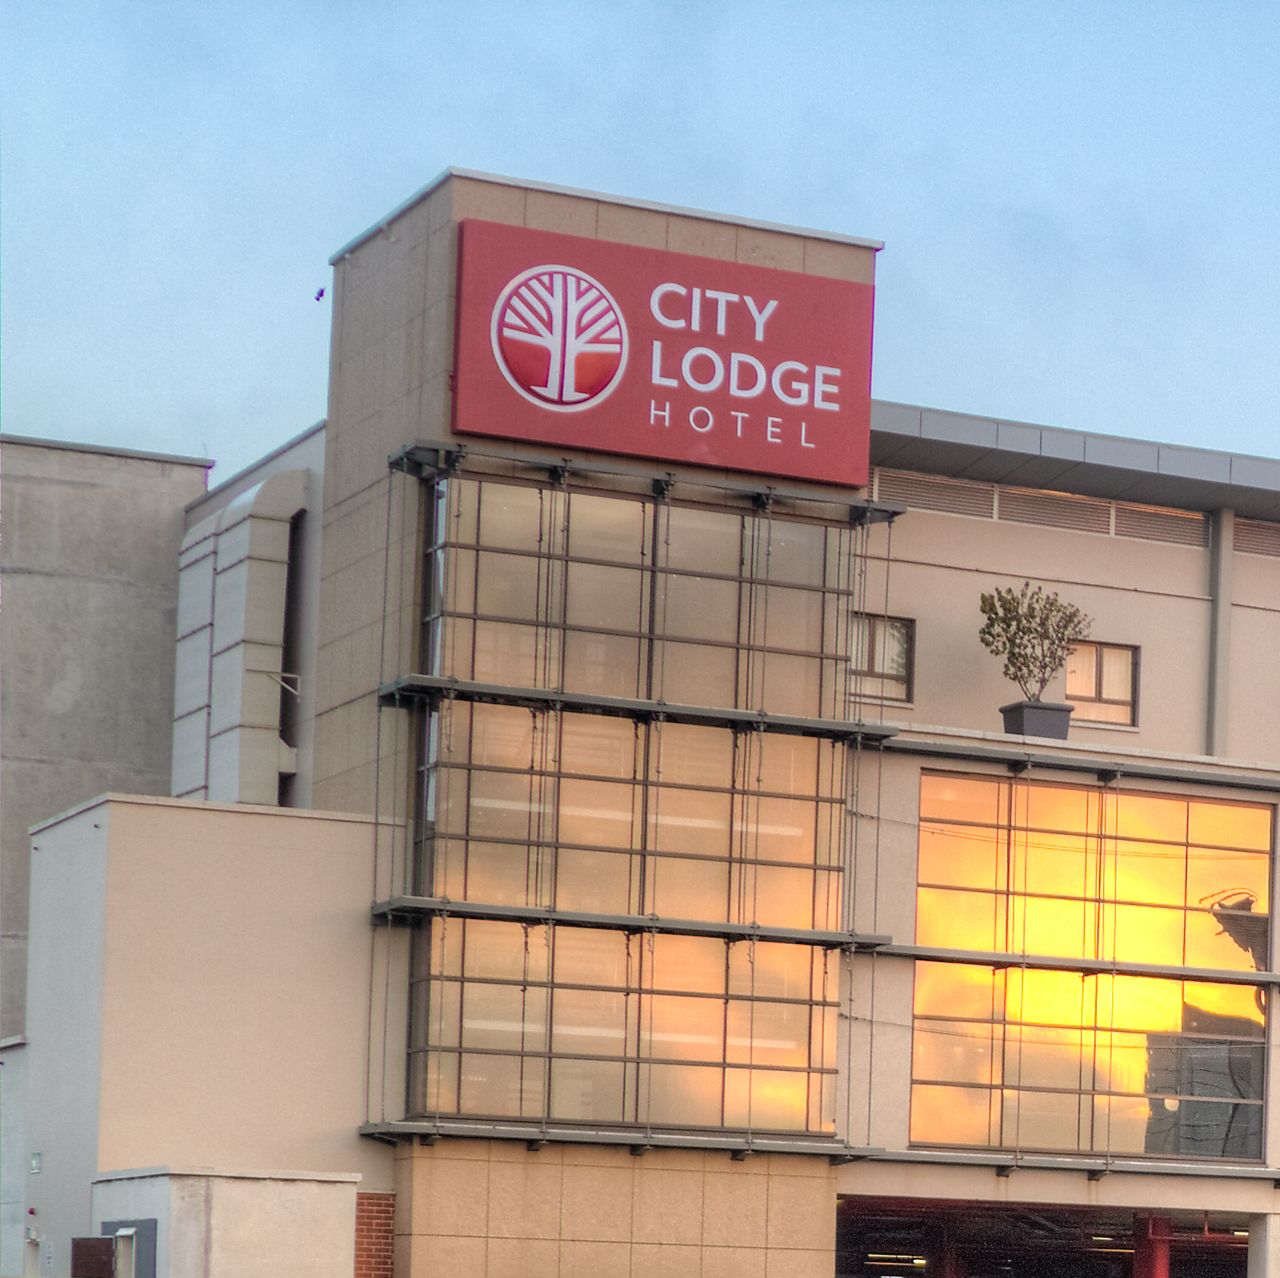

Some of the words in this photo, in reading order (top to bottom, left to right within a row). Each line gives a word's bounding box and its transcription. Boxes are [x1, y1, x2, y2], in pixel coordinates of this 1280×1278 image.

[649, 282, 779, 342] CITY
[650, 340, 841, 411] LODGE
[649, 399, 816, 448] HOTEL
